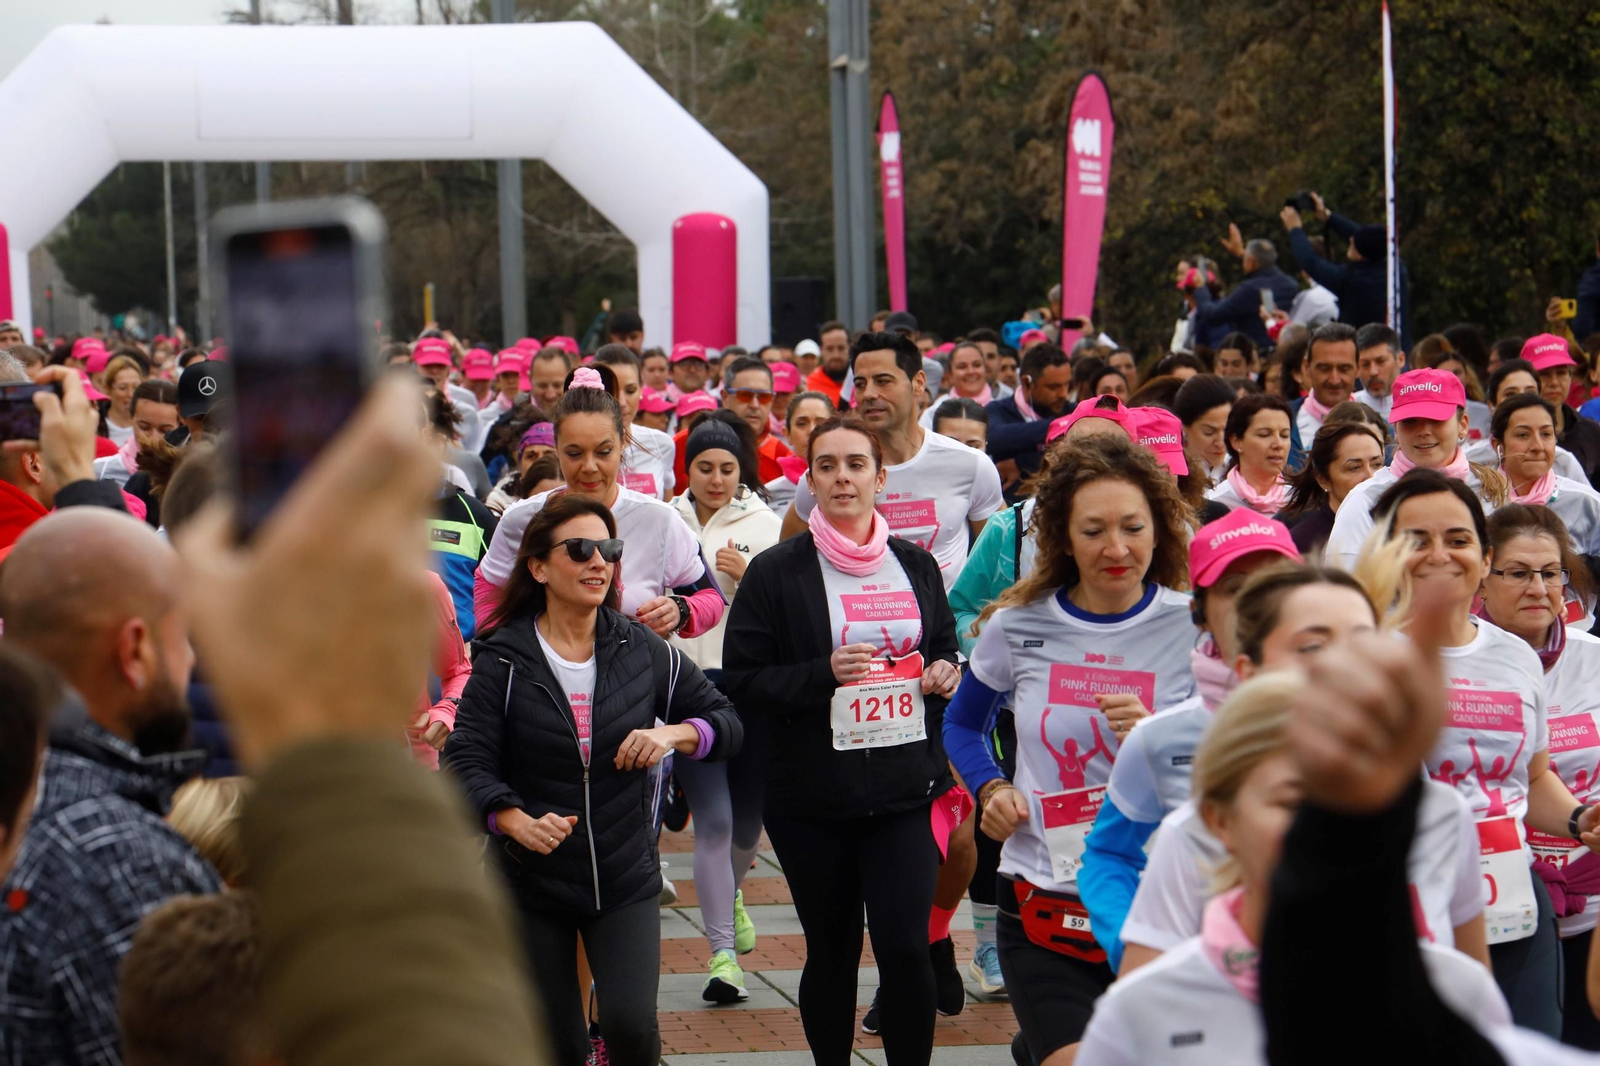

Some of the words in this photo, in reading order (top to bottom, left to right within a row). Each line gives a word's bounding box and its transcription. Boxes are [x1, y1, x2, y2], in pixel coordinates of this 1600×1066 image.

[1400, 381, 1442, 396] sinvello!
[1139, 433, 1178, 446] sinvello!
[892, 509, 928, 519] RUNNING
[1209, 523, 1276, 550] sinvello!
[735, 543, 750, 553] ILA
[851, 603, 873, 611] PINK
[874, 600, 912, 610] RUNNING
[865, 610, 892, 618] CADENA
[1091, 673, 1121, 683] Edición
[1060, 678, 1087, 691] PINK
[1090, 681, 1143, 697] RUNNING
[1073, 692, 1096, 703] CADE
[1465, 693, 1493, 702] Edición
[849, 692, 913, 723] 1218
[1466, 702, 1515, 716] RUNNING
[1453, 714, 1487, 724] CADENA
[1488, 716, 1502, 725] 100
[1550, 721, 1565, 730] ción
[1549, 725, 1589, 739] UNNING
[1548, 740, 1564, 749] ENA
[1564, 738, 1578, 746] 100
[1080, 804, 1095, 812] PINK
[1071, 917, 1085, 928] 59
